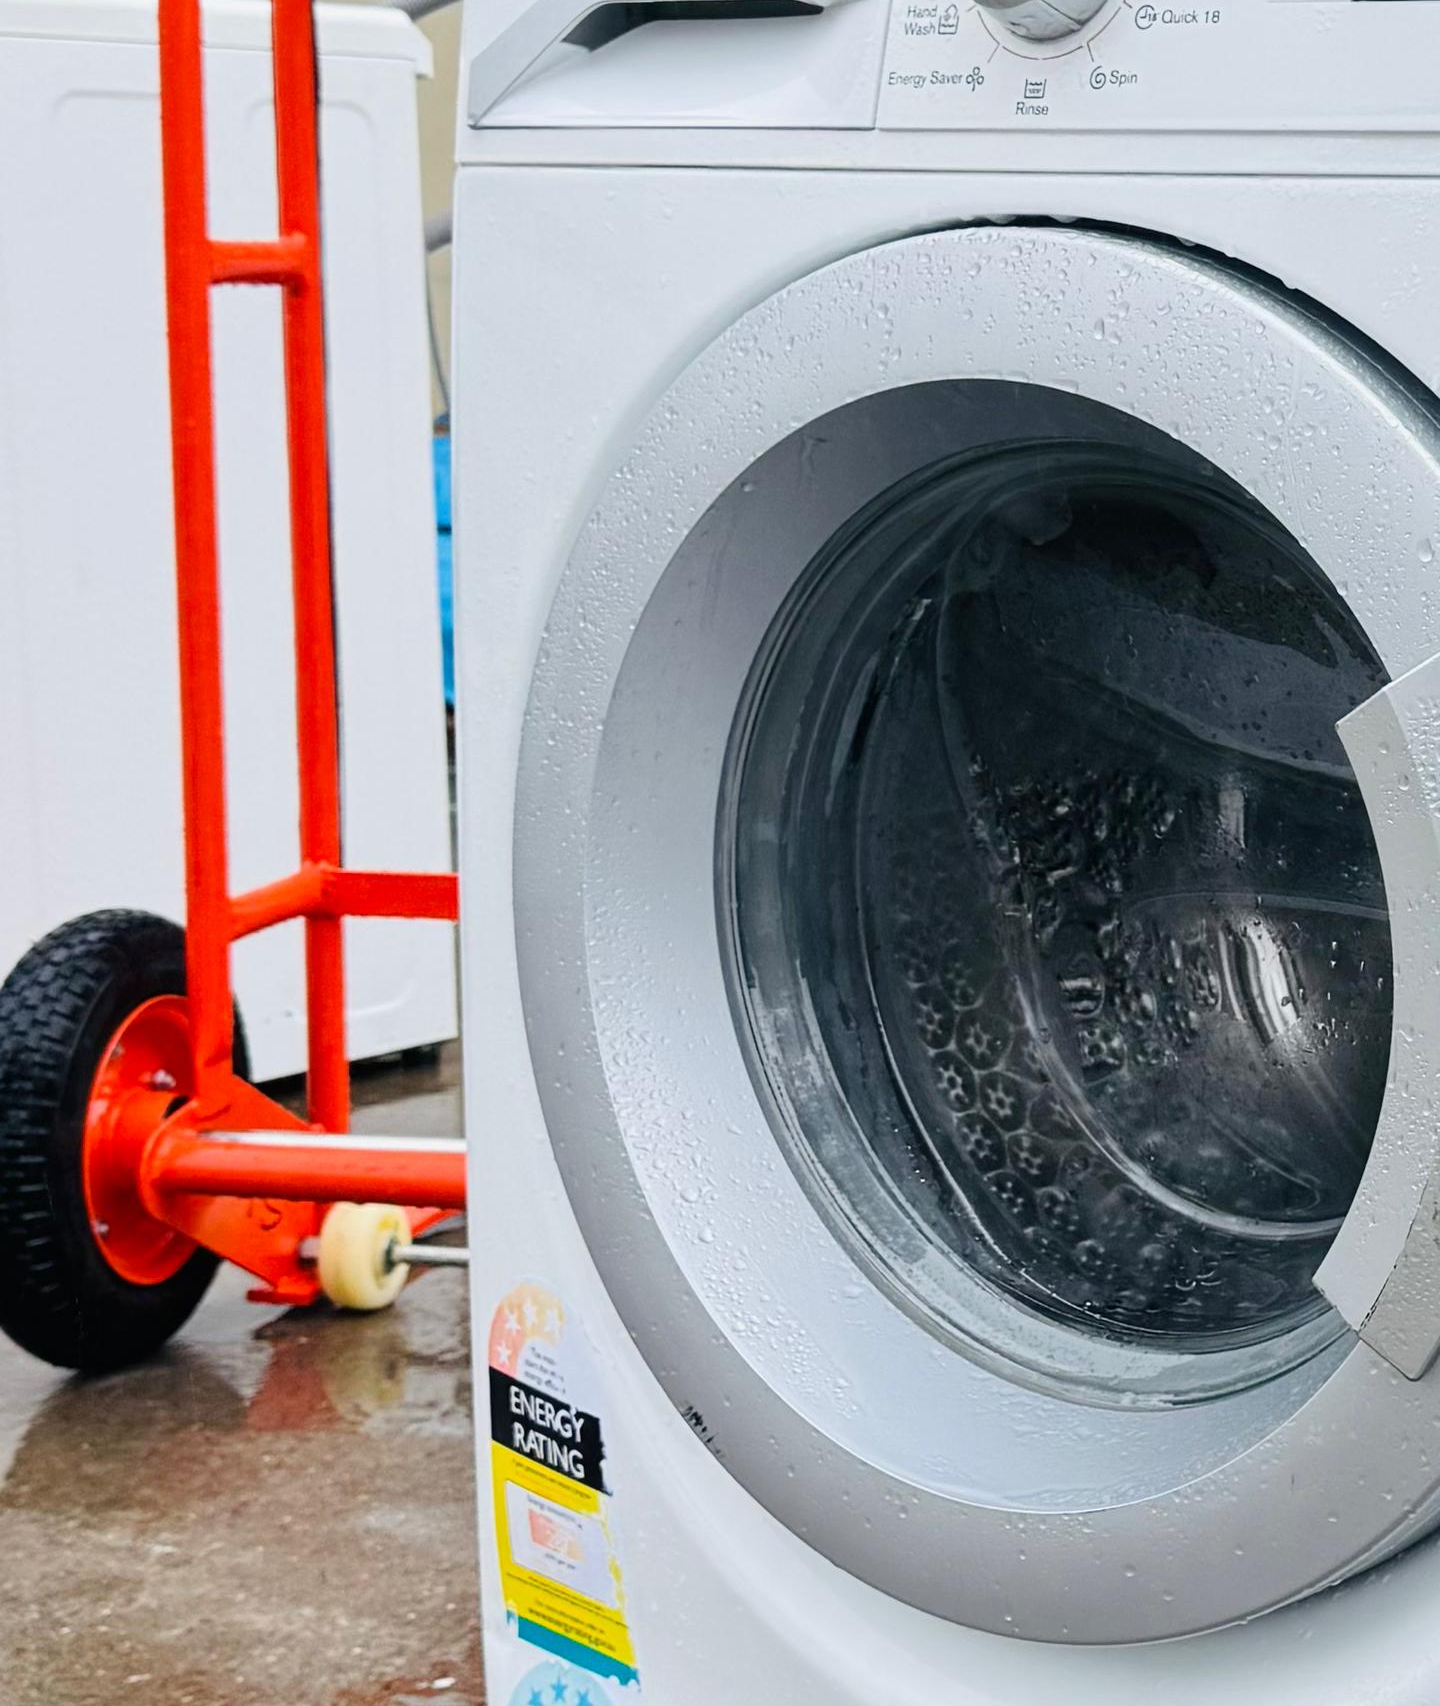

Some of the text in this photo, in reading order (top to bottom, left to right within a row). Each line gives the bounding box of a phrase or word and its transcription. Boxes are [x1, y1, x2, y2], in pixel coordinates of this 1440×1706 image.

[907, 4, 938, 18] Hand
[1161, 9, 1220, 24] Quick 18
[904, 22, 935, 35] Wash
[888, 70, 962, 89] Energy Saver
[1109, 70, 1138, 87] Spin
[1015, 101, 1049, 115] Rinse
[509, 1384, 585, 1444] ENERGY
[512, 1422, 585, 1479] RATING
